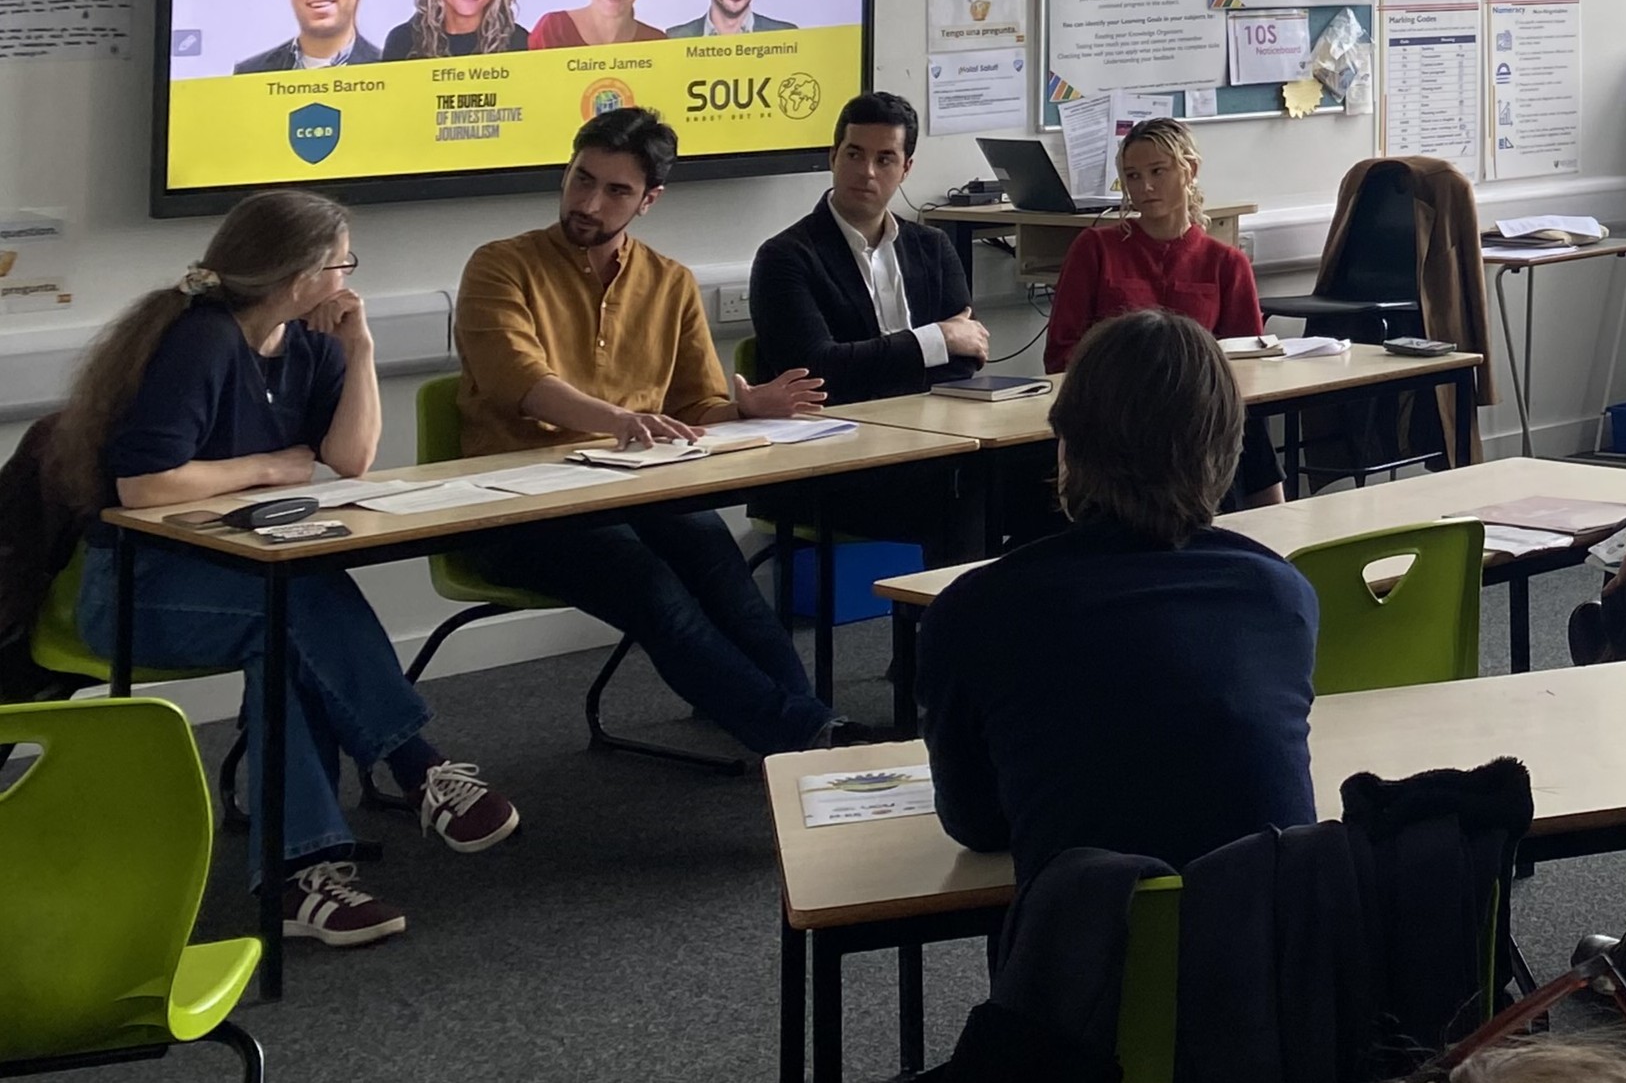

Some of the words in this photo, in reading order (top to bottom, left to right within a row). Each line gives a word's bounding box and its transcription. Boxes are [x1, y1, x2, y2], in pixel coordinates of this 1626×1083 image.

[1493, 7, 1525, 15] Numeracy
[1389, 16, 1415, 24] Marking
[1417, 15, 1437, 23] Codes
[1244, 25, 1277, 45] 10S
[686, 46, 731, 57] Matteo
[735, 42, 798, 58] Bergamini
[1255, 47, 1301, 55] Noticeboard
[567, 58, 606, 71] Claire
[609, 58, 652, 70] James
[432, 68, 465, 82] Effie
[469, 67, 510, 80] Webb
[267, 81, 329, 96] Thomas
[333, 79, 386, 94] Barton
[686, 77, 772, 112] SOUK
[436, 94, 455, 110] THE
[457, 93, 497, 109] BUREAU
[436, 111, 449, 126] OF
[450, 107, 522, 125] INVESTIGATIVE
[435, 125, 500, 142] JOURNALISM
